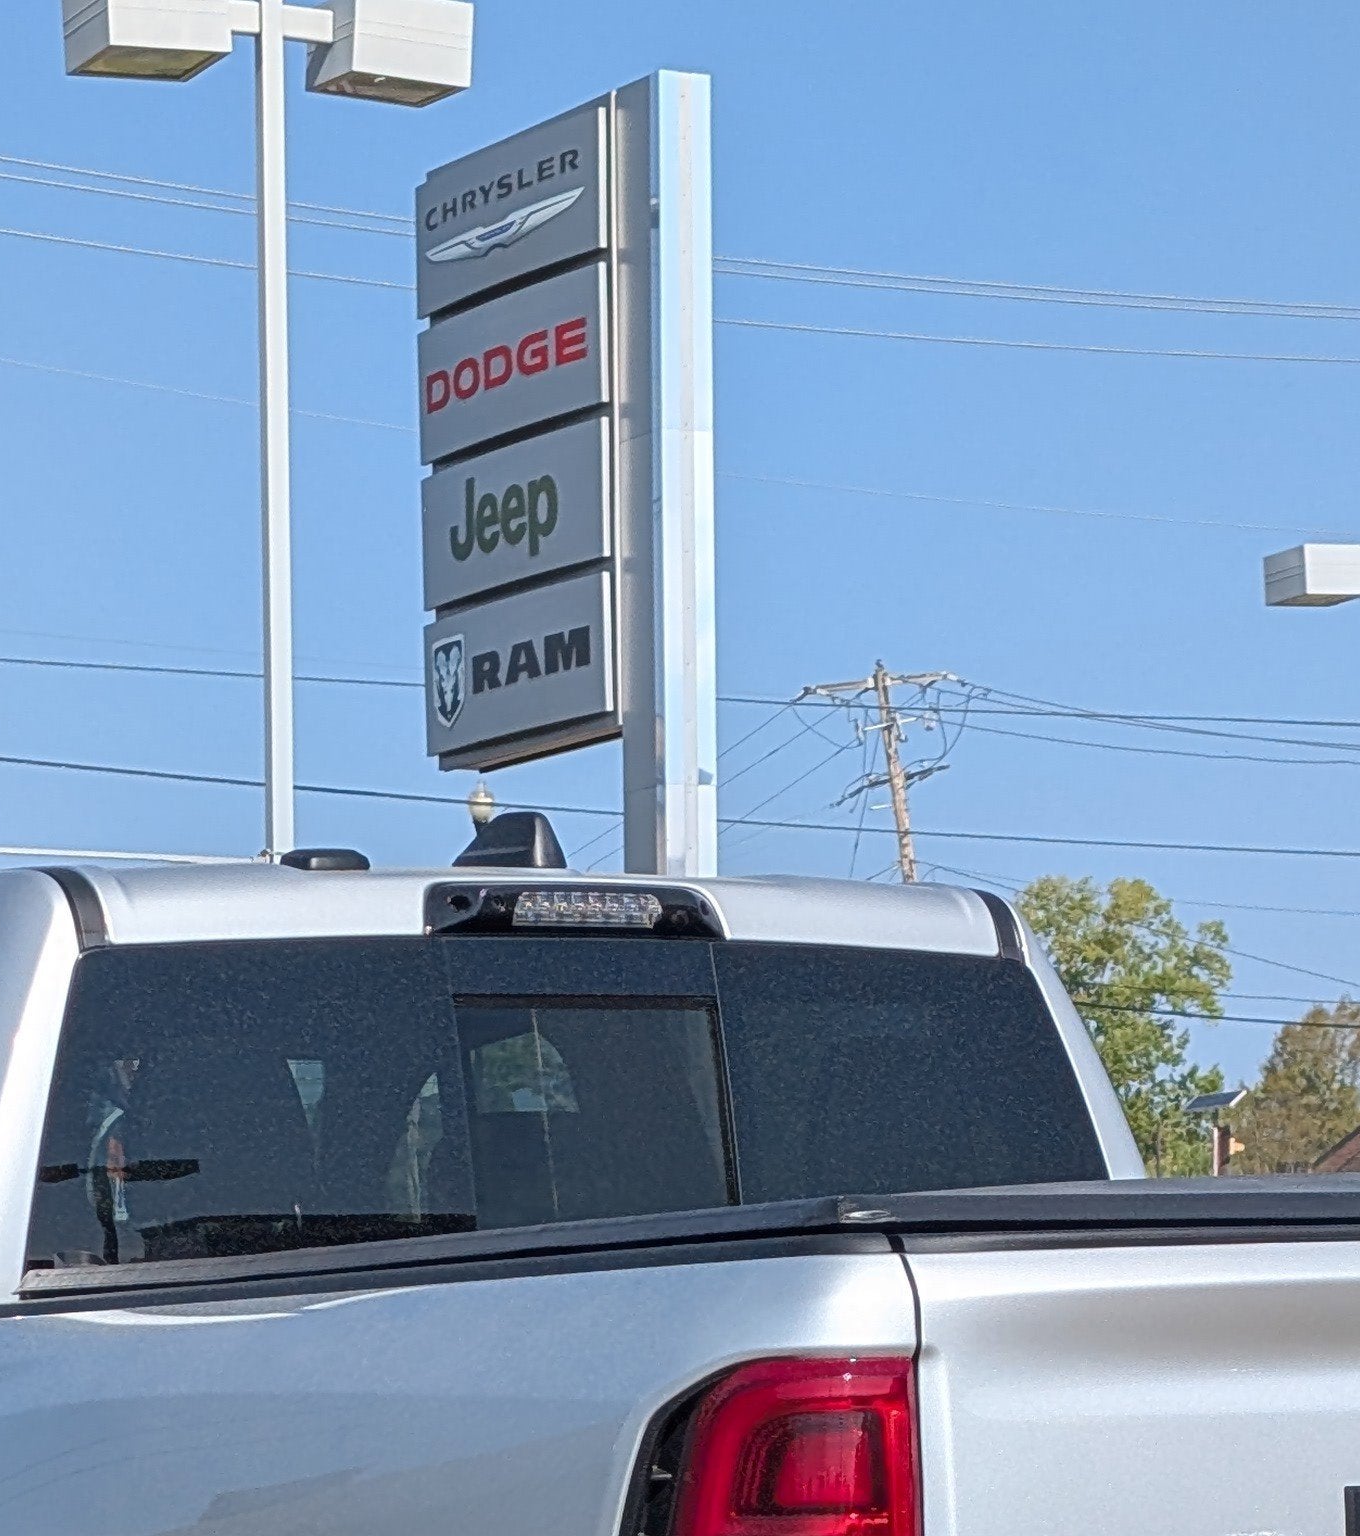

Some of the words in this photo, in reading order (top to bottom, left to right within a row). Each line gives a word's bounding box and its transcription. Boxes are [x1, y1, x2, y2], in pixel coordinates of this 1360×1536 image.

[425, 147, 581, 232] CHRYSLER
[426, 316, 588, 415] DODGE
[450, 473, 558, 561] Jeep
[472, 625, 591, 695] RAM
